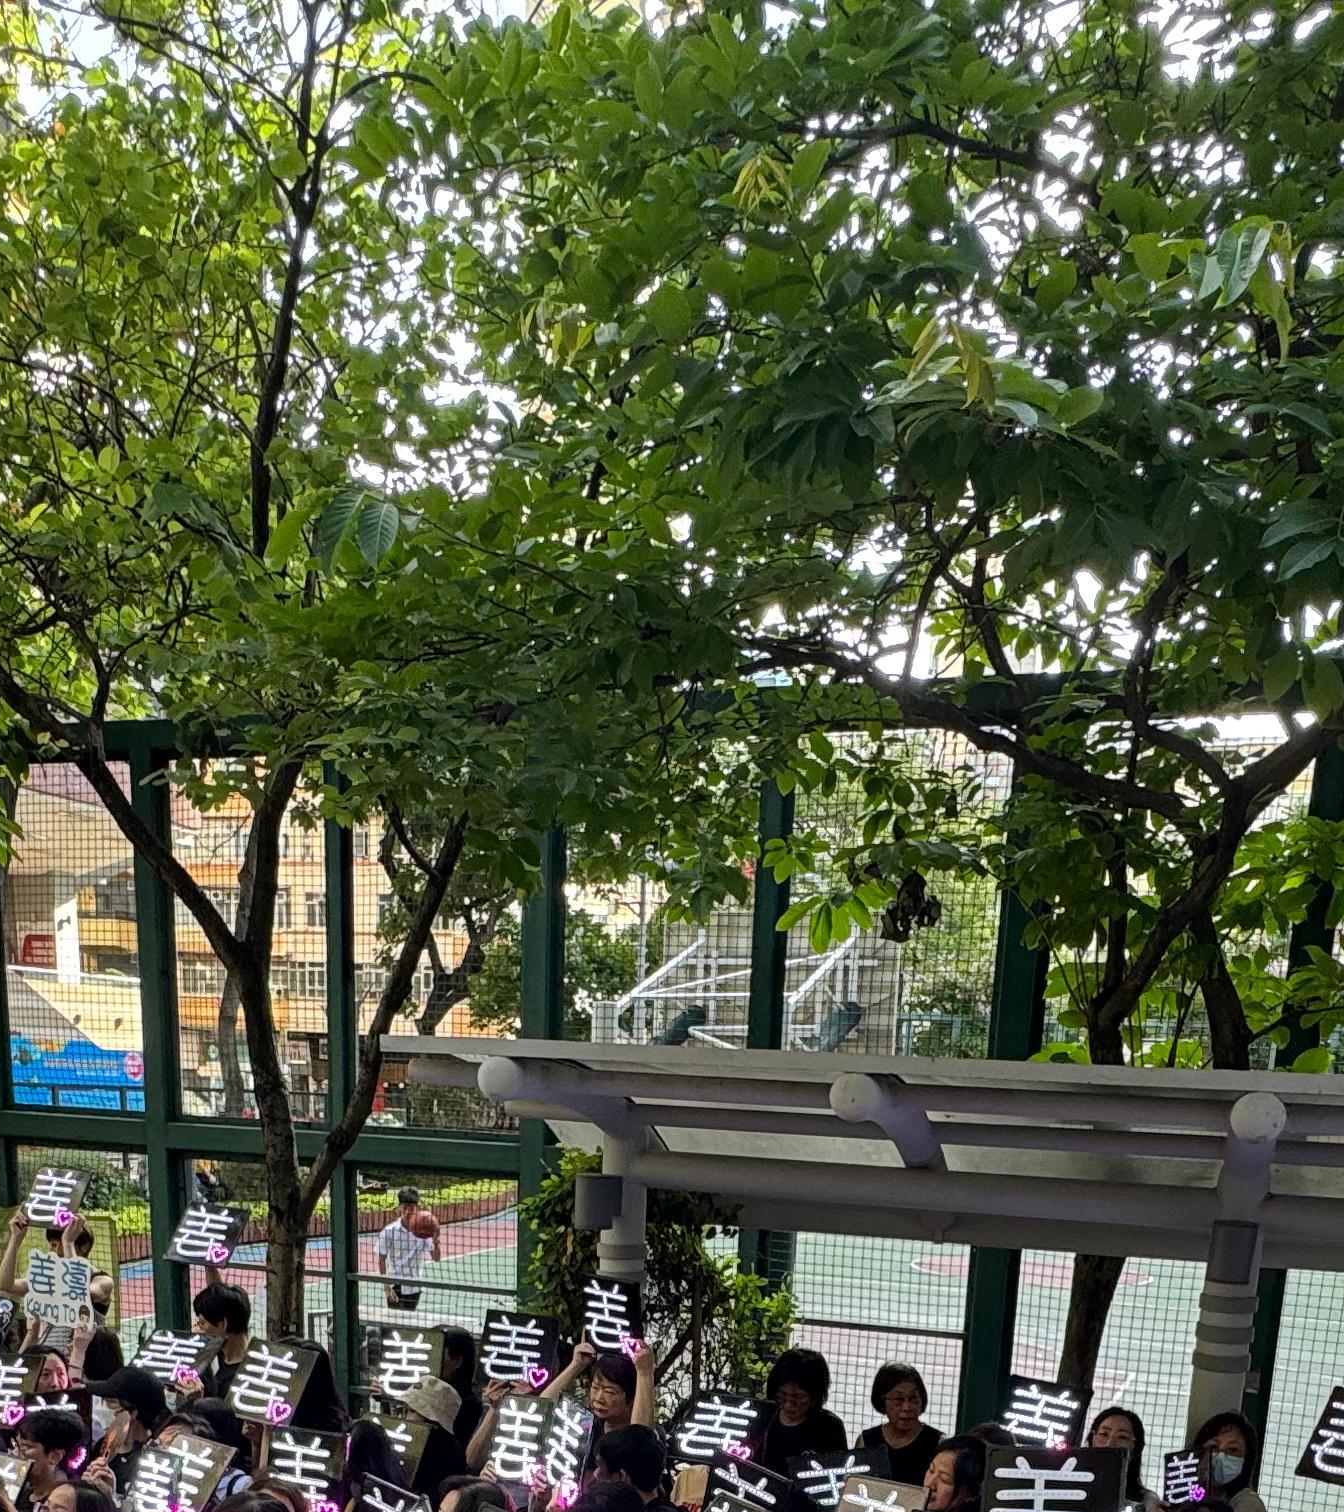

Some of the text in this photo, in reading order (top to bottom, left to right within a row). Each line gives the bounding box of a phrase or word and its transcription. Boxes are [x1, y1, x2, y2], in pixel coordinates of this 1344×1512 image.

[25, 1168, 77, 1222] 姜
[173, 1206, 233, 1258] 姜
[29, 1251, 88, 1303] 姜濤
[27, 1298, 59, 1323] Keung
[584, 1280, 632, 1350] 姜
[481, 1316, 545, 1382] 姜
[231, 1345, 299, 1420] 姜
[492, 1399, 544, 1481] 姜
[678, 1396, 757, 1457] 姜
[1165, 1453, 1200, 1505] 姜
